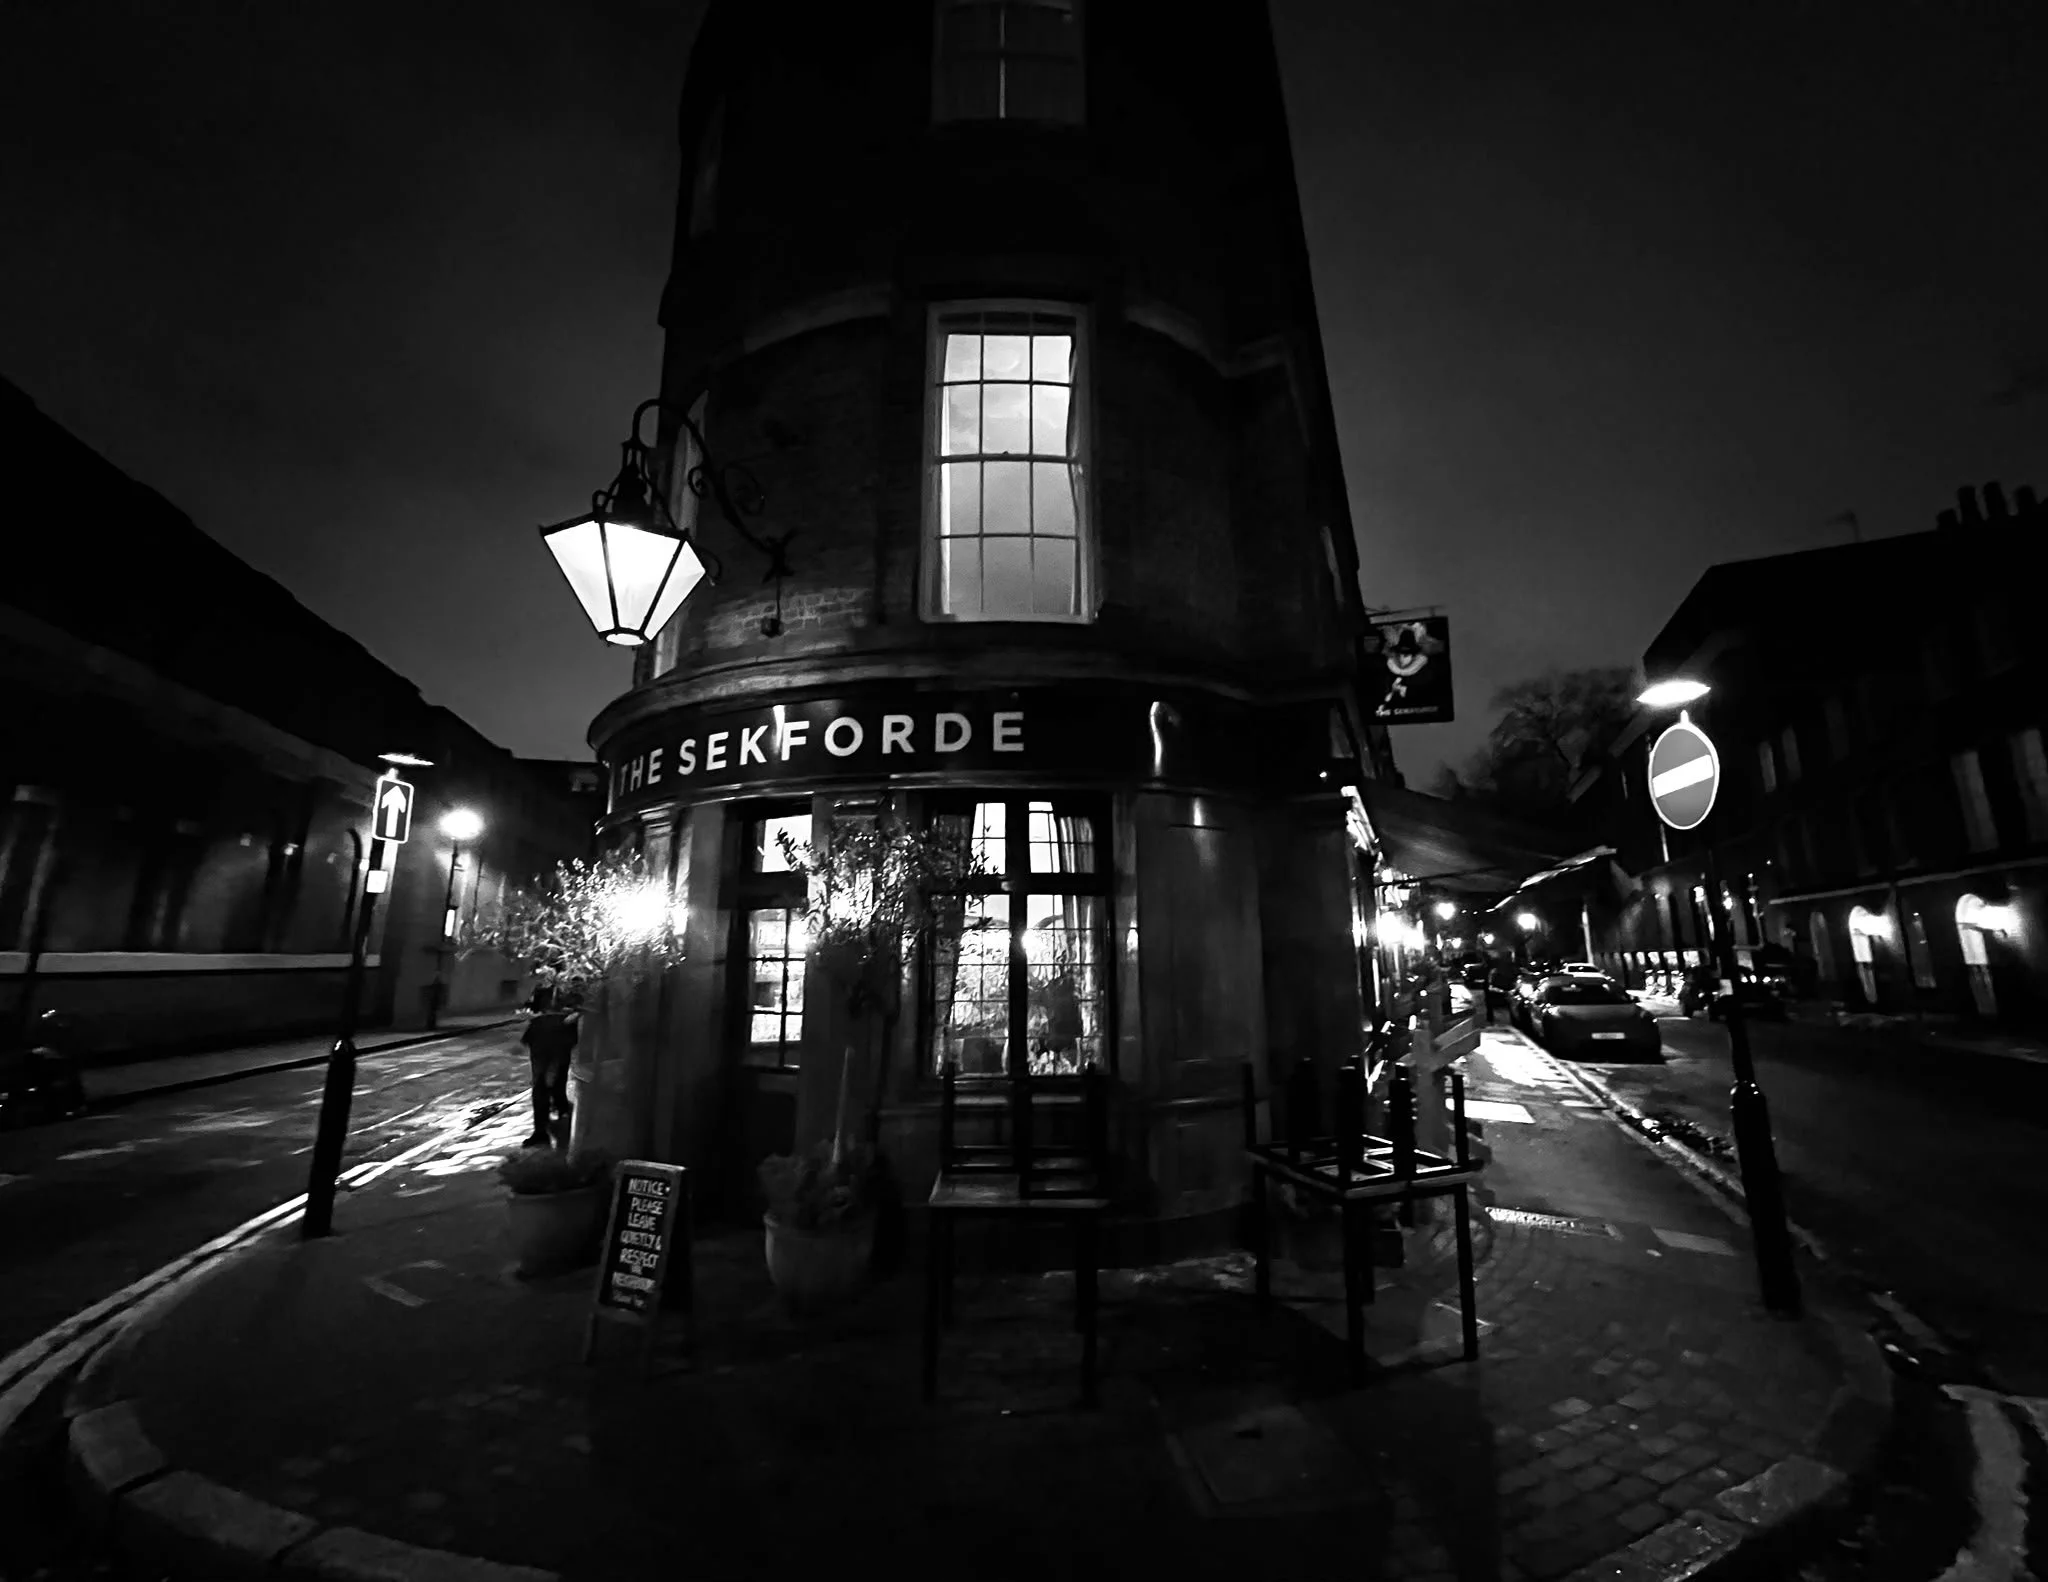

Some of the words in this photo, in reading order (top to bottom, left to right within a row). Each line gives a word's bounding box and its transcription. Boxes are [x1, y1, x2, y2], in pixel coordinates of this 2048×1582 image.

[619, 748, 664, 796] THE
[678, 711, 1025, 774] SEKFORDE
[631, 1197, 664, 1215] PLEASE
[627, 1212, 656, 1231] LEAVE
[619, 1248, 659, 1270] RESPECT
